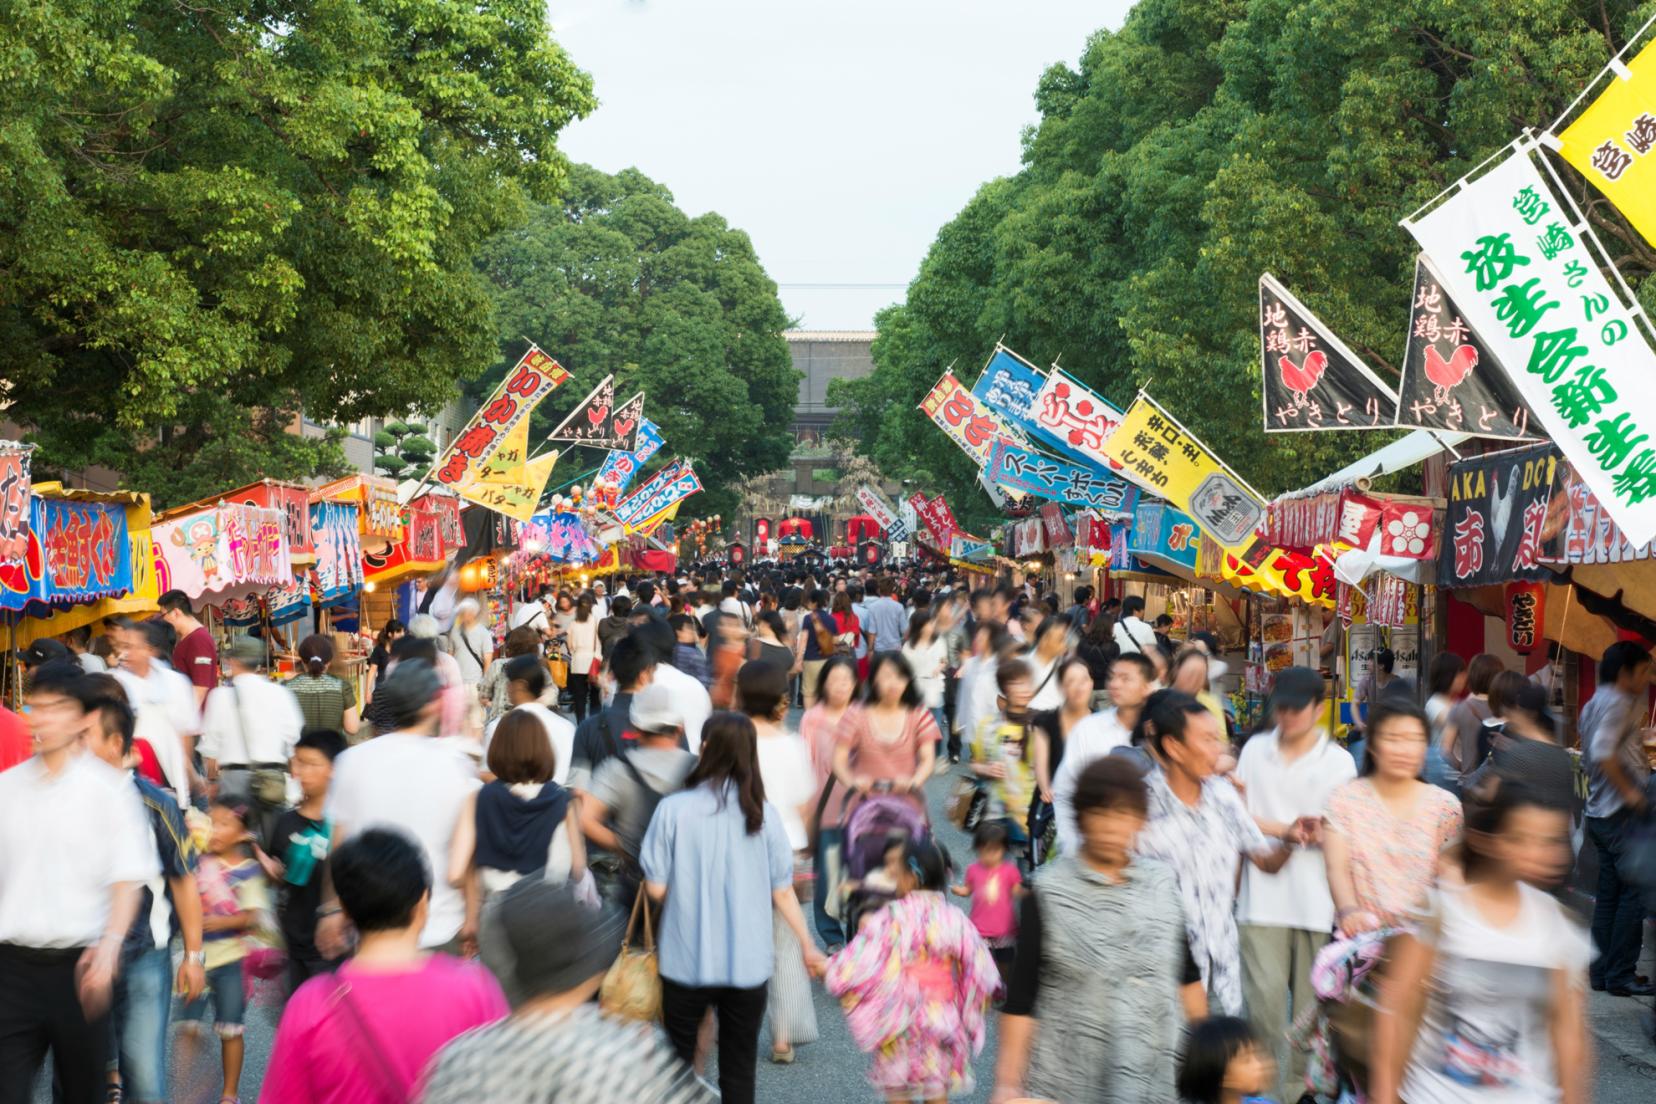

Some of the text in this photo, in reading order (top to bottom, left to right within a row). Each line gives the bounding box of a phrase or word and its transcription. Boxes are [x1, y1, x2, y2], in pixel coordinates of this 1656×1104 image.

[1275, 398, 1379, 428] やきとり
[1410, 399, 1528, 437] やきとり
[438, 366, 541, 485] いか焼き
[563, 426, 605, 440] やきとり
[498, 449, 519, 461] ャガ
[480, 466, 506, 478] ター
[1452, 470, 1486, 501] AKA
[481, 489, 517, 507] バター
